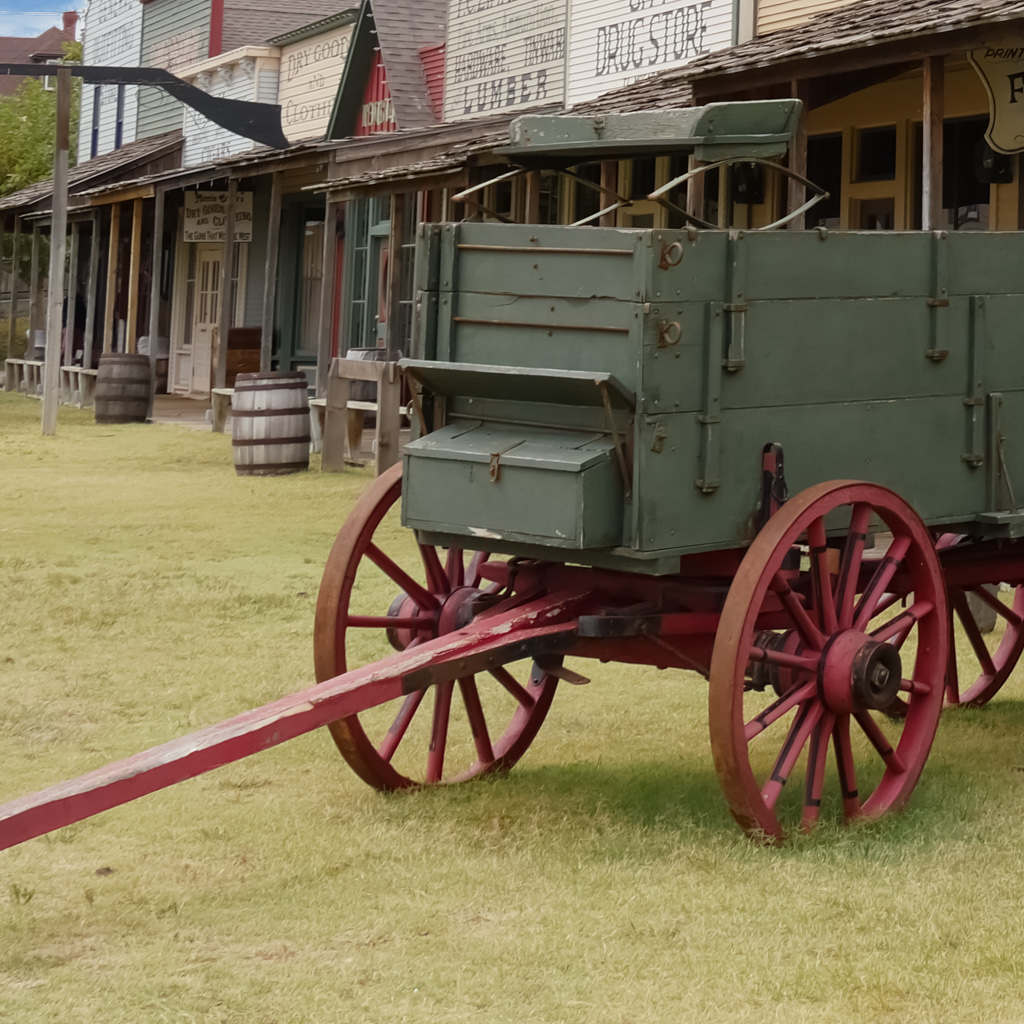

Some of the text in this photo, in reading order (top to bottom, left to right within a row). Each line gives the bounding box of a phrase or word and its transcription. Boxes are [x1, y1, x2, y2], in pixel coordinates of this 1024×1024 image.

[524, 28, 565, 67] TINWAR
[594, 1, 713, 77] DRUG STORE
[287, 36, 350, 83] DRY GOOD
[308, 73, 325, 90] AND
[463, 69, 547, 114] LUMBER
[285, 100, 333, 125] CLOTHI
[186, 207, 201, 219] DRY
[196, 217, 209, 226] AND
